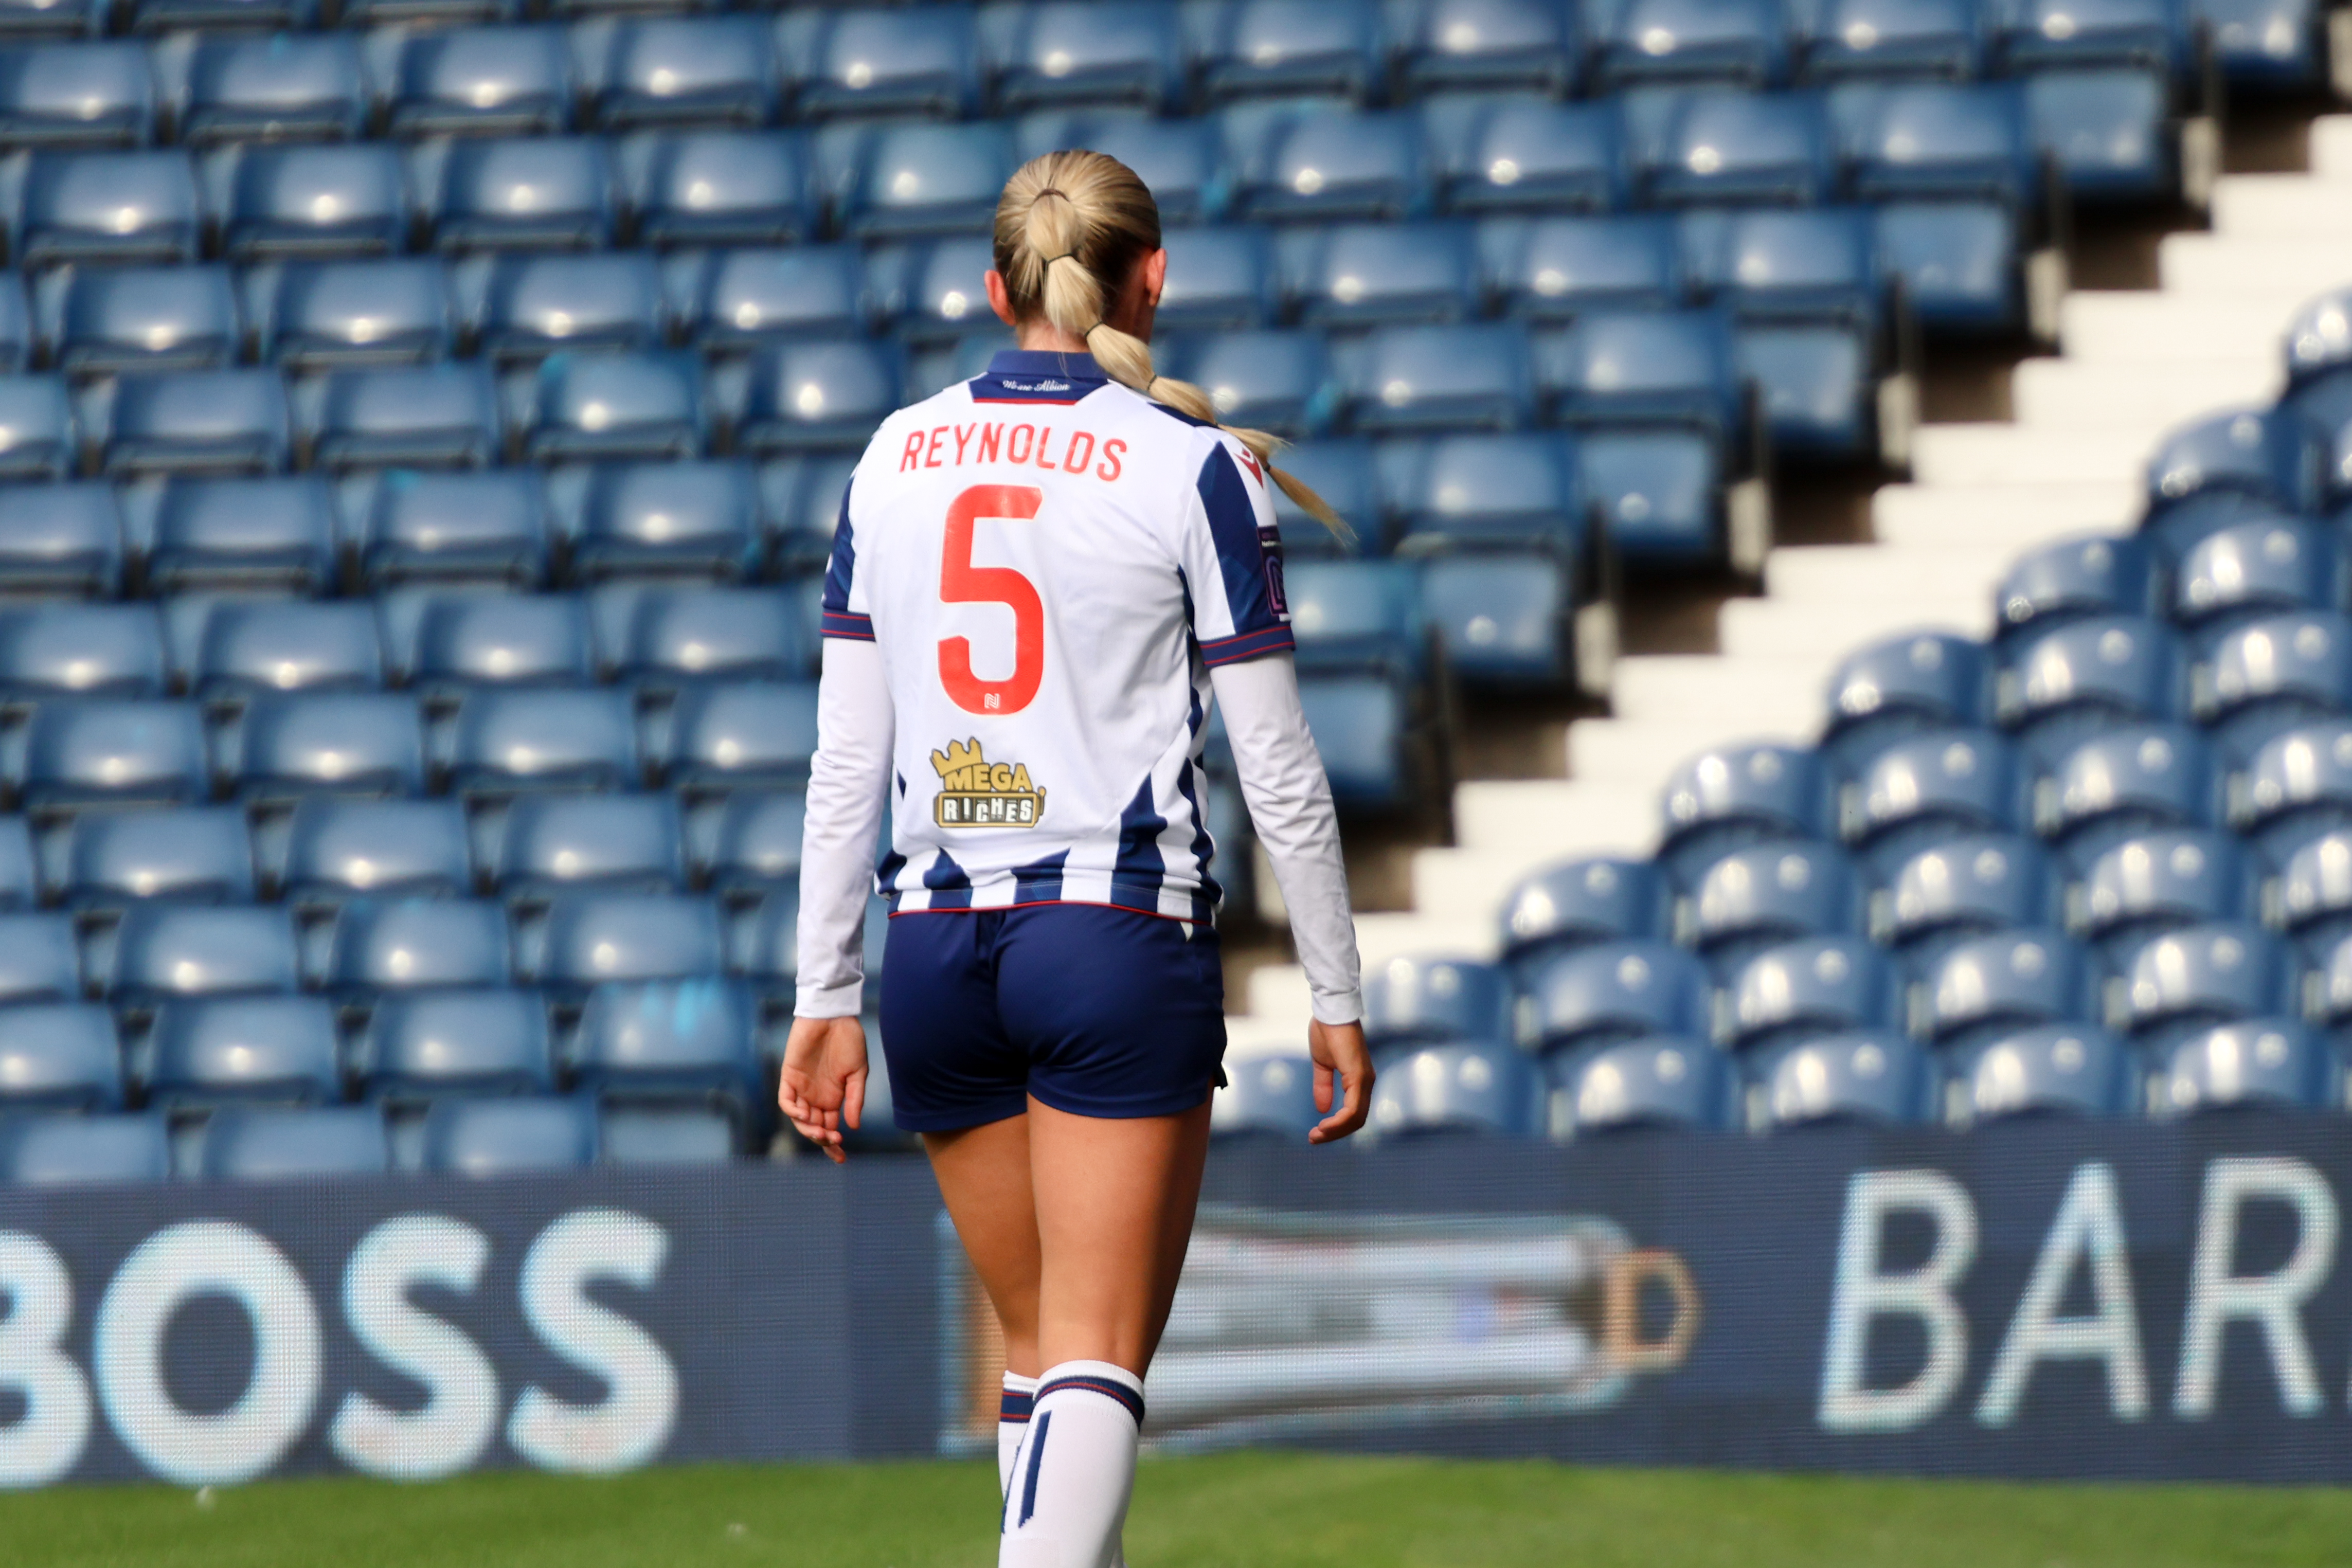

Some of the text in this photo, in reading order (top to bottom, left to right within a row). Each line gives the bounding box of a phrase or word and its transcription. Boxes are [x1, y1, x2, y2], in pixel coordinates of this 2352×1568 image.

[1034, 379, 1071, 391] Albion
[900, 422, 1128, 481] REYNOLDS
[938, 483, 1044, 716] 5
[944, 763, 1033, 792] MEGA
[944, 797, 1033, 822] RICHES
[1817, 1155, 2352, 1435] BAR
